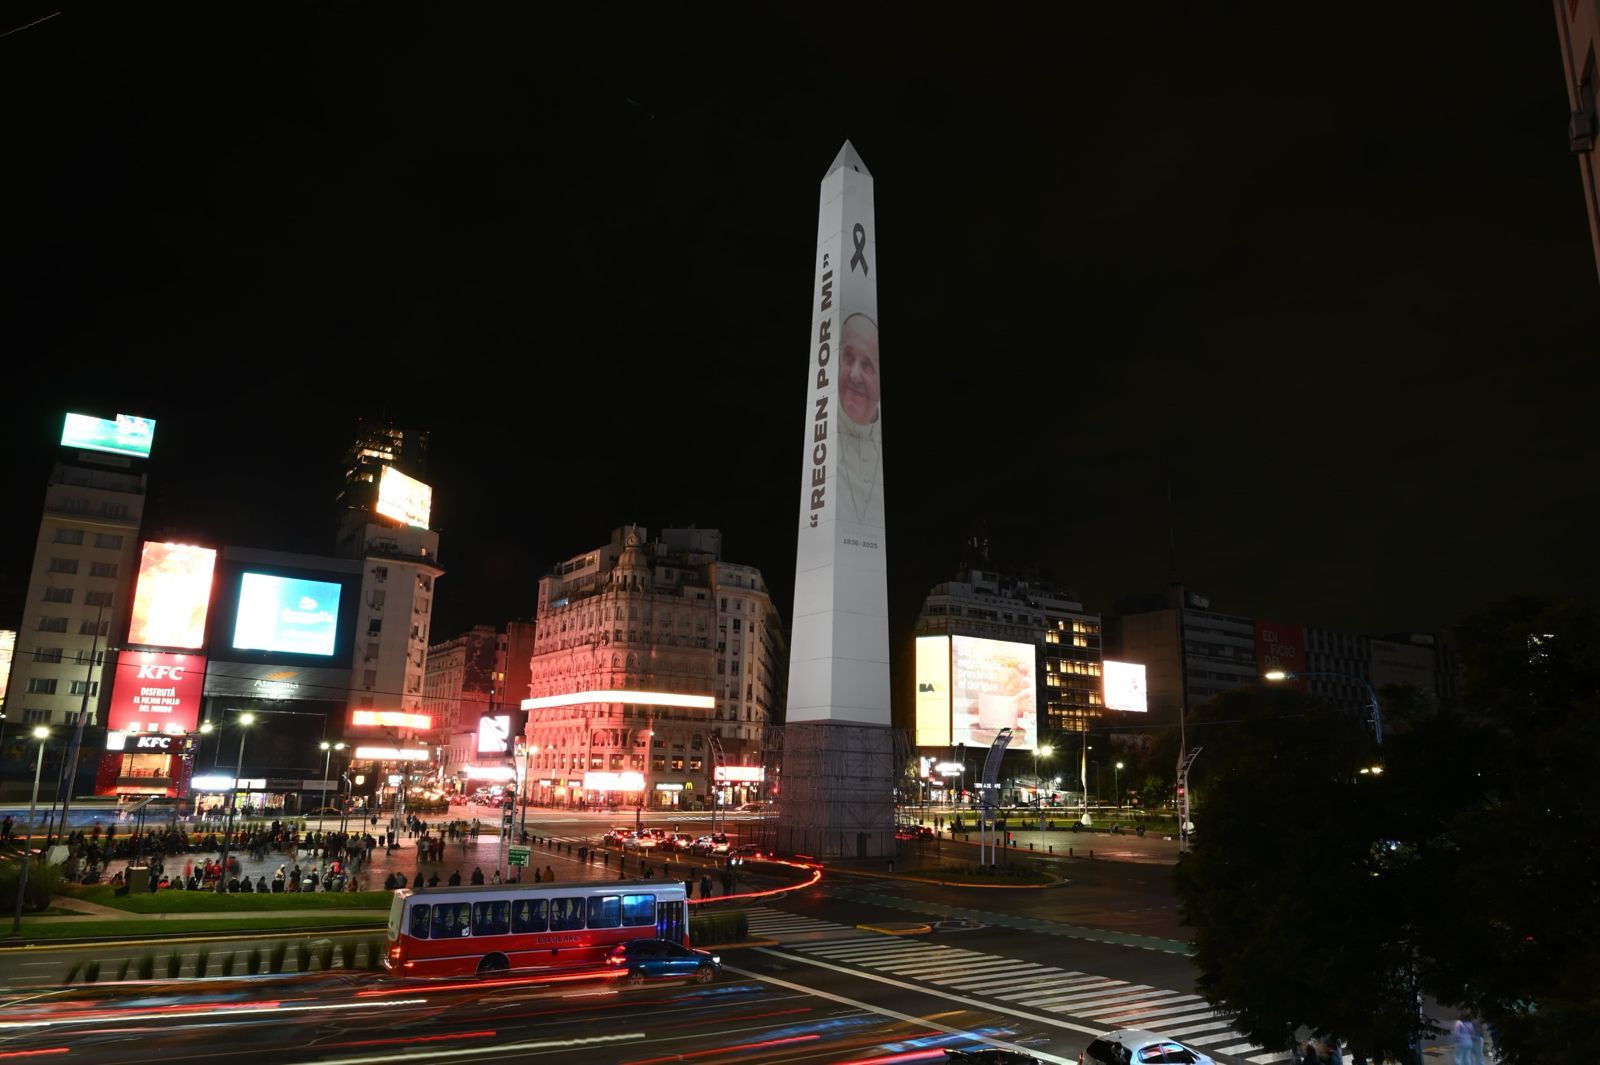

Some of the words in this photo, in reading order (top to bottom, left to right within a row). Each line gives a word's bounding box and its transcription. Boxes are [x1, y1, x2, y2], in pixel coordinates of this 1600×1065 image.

[816, 317, 832, 390] POR
[1263, 630, 1278, 642] EDI
[1270, 643, 1296, 659] FICIO
[137, 664, 185, 681] KFC
[918, 683, 935, 692] BA
[133, 696, 141, 704] EL
[161, 697, 181, 706] POLLO
[138, 704, 150, 712] DEL
[137, 737, 172, 748] KFC
